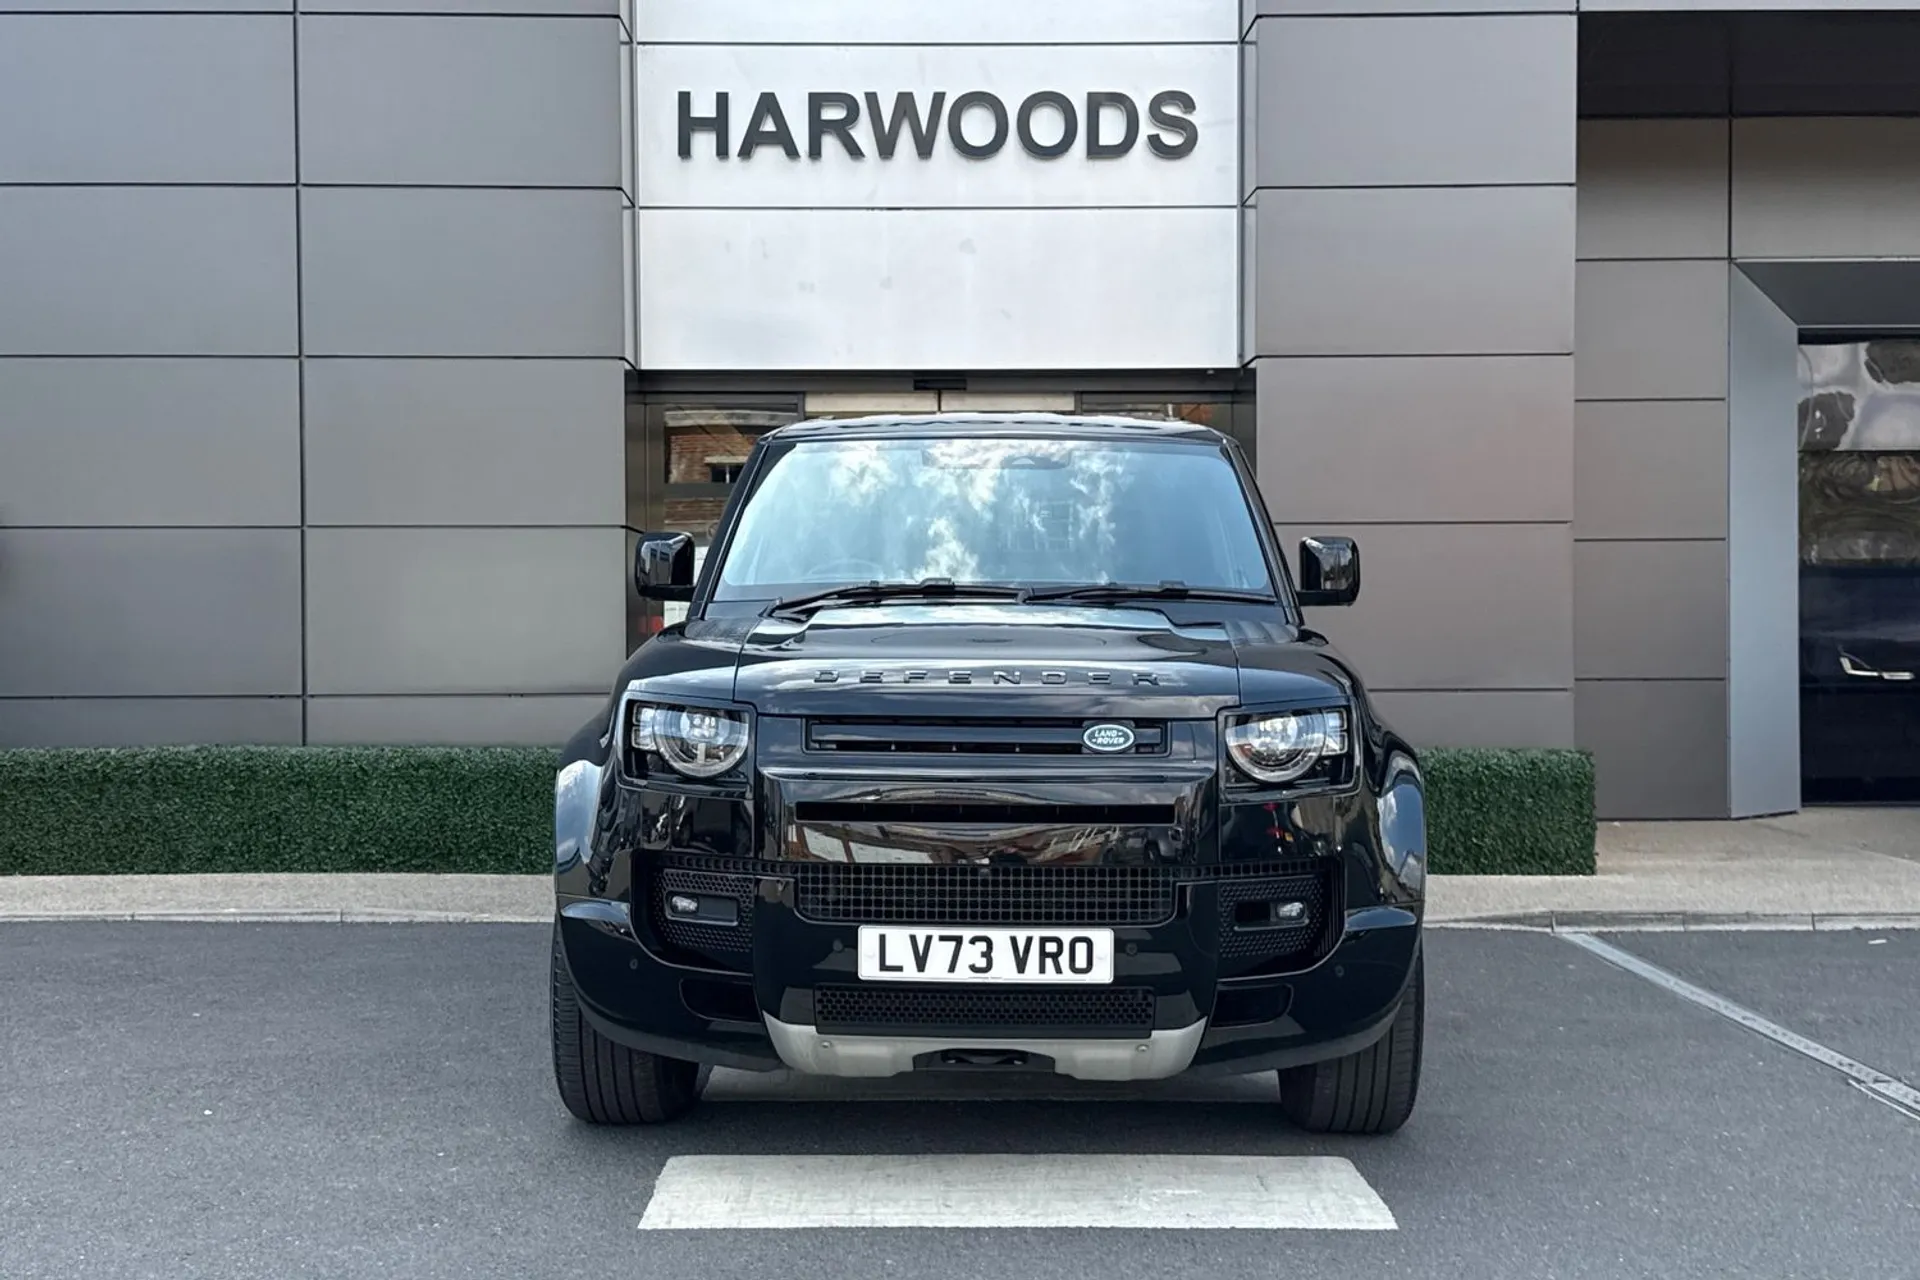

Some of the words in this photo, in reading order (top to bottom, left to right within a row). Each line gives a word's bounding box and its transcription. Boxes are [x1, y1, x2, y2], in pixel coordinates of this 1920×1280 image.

[677, 90, 1199, 160] HARWOODS
[814, 669, 1160, 686] DEFENDER
[878, 933, 994, 973] LV73
[1010, 936, 1094, 974] VRO
